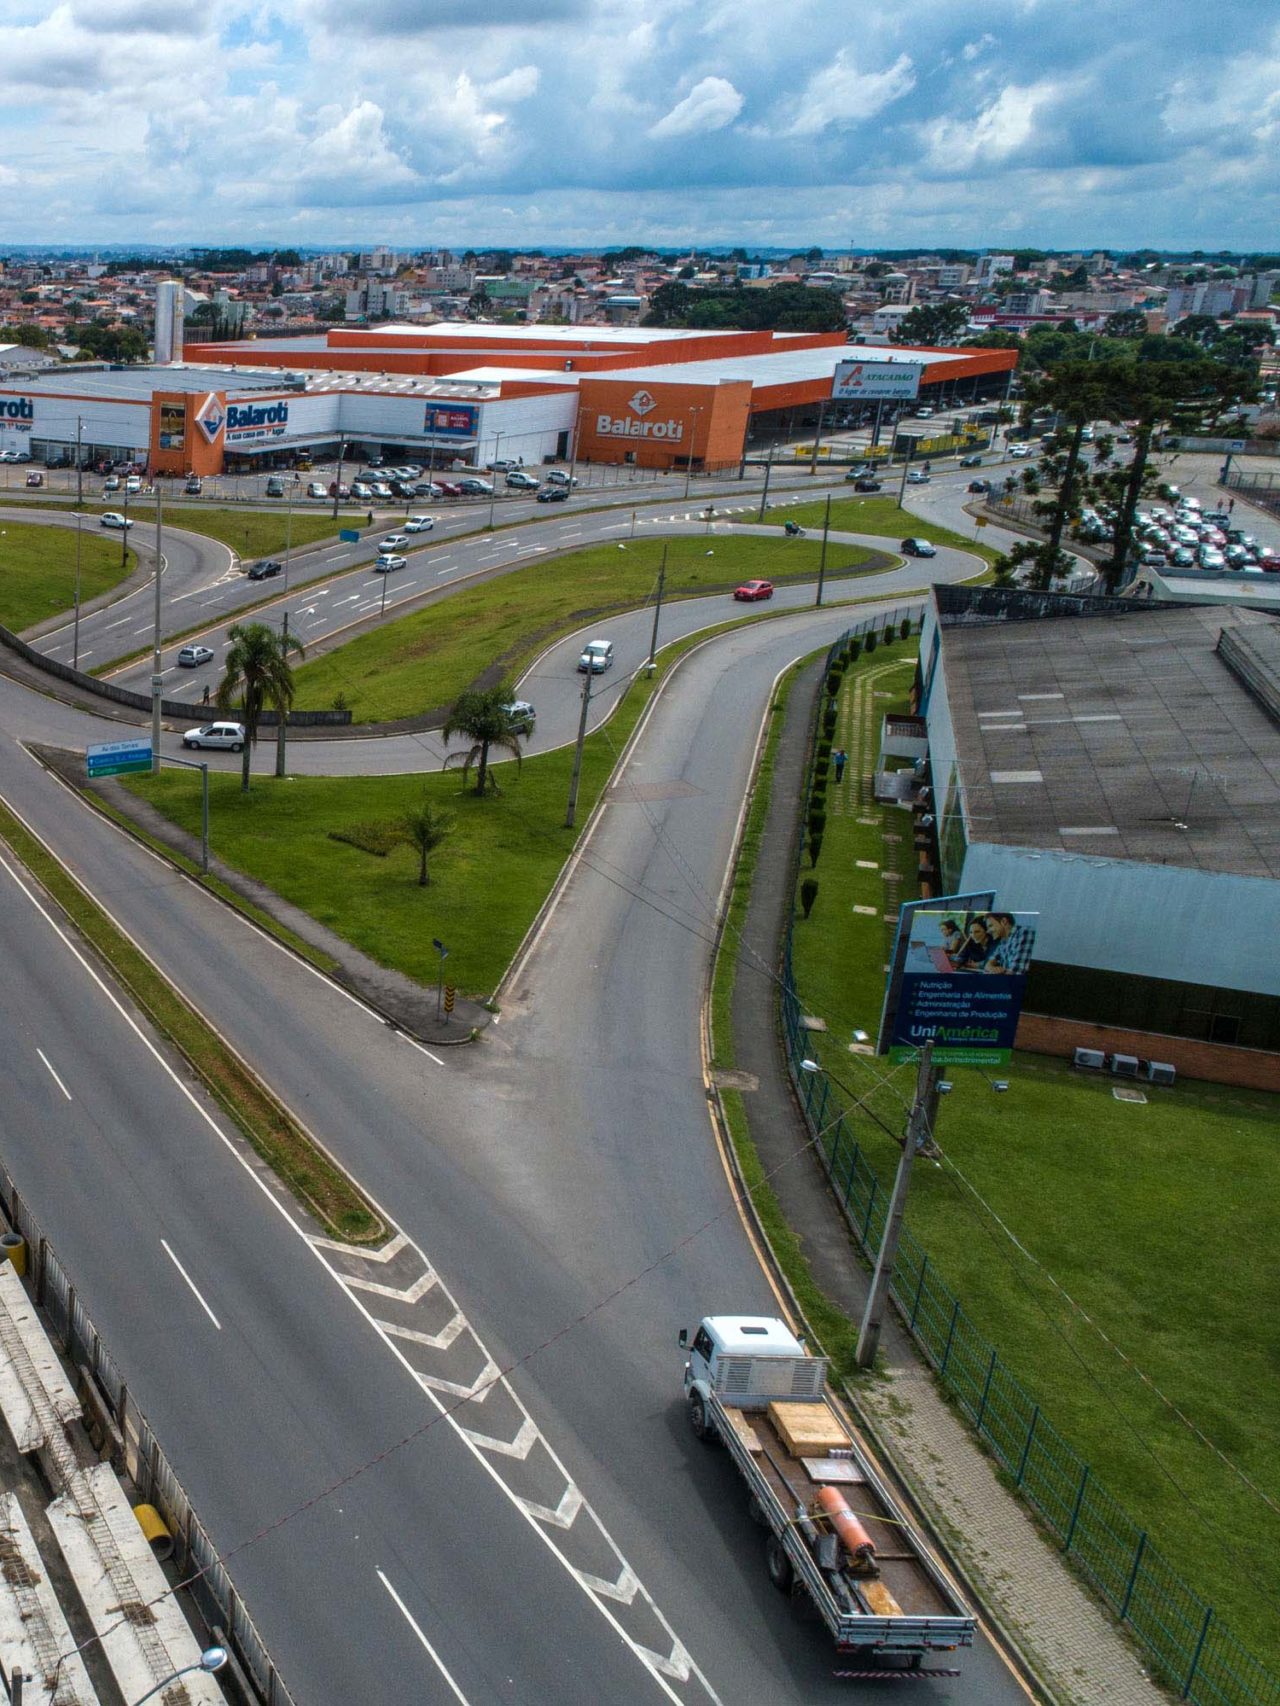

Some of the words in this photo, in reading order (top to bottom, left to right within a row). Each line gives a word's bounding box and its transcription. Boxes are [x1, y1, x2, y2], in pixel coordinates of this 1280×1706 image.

[226, 400, 289, 429] Balaroti
[597, 414, 684, 439] Balaroti
[920, 981, 953, 990] Nutrição
[918, 991, 961, 999] Engenharia
[962, 991, 973, 999] de
[974, 991, 1012, 1000] Alimentos
[915, 1000, 971, 1009] Administração
[914, 1009, 957, 1018] Engenharia
[958, 1010, 969, 1018] de
[970, 1010, 1008, 1020] Produção
[910, 1025, 999, 1040] UniAmérica
